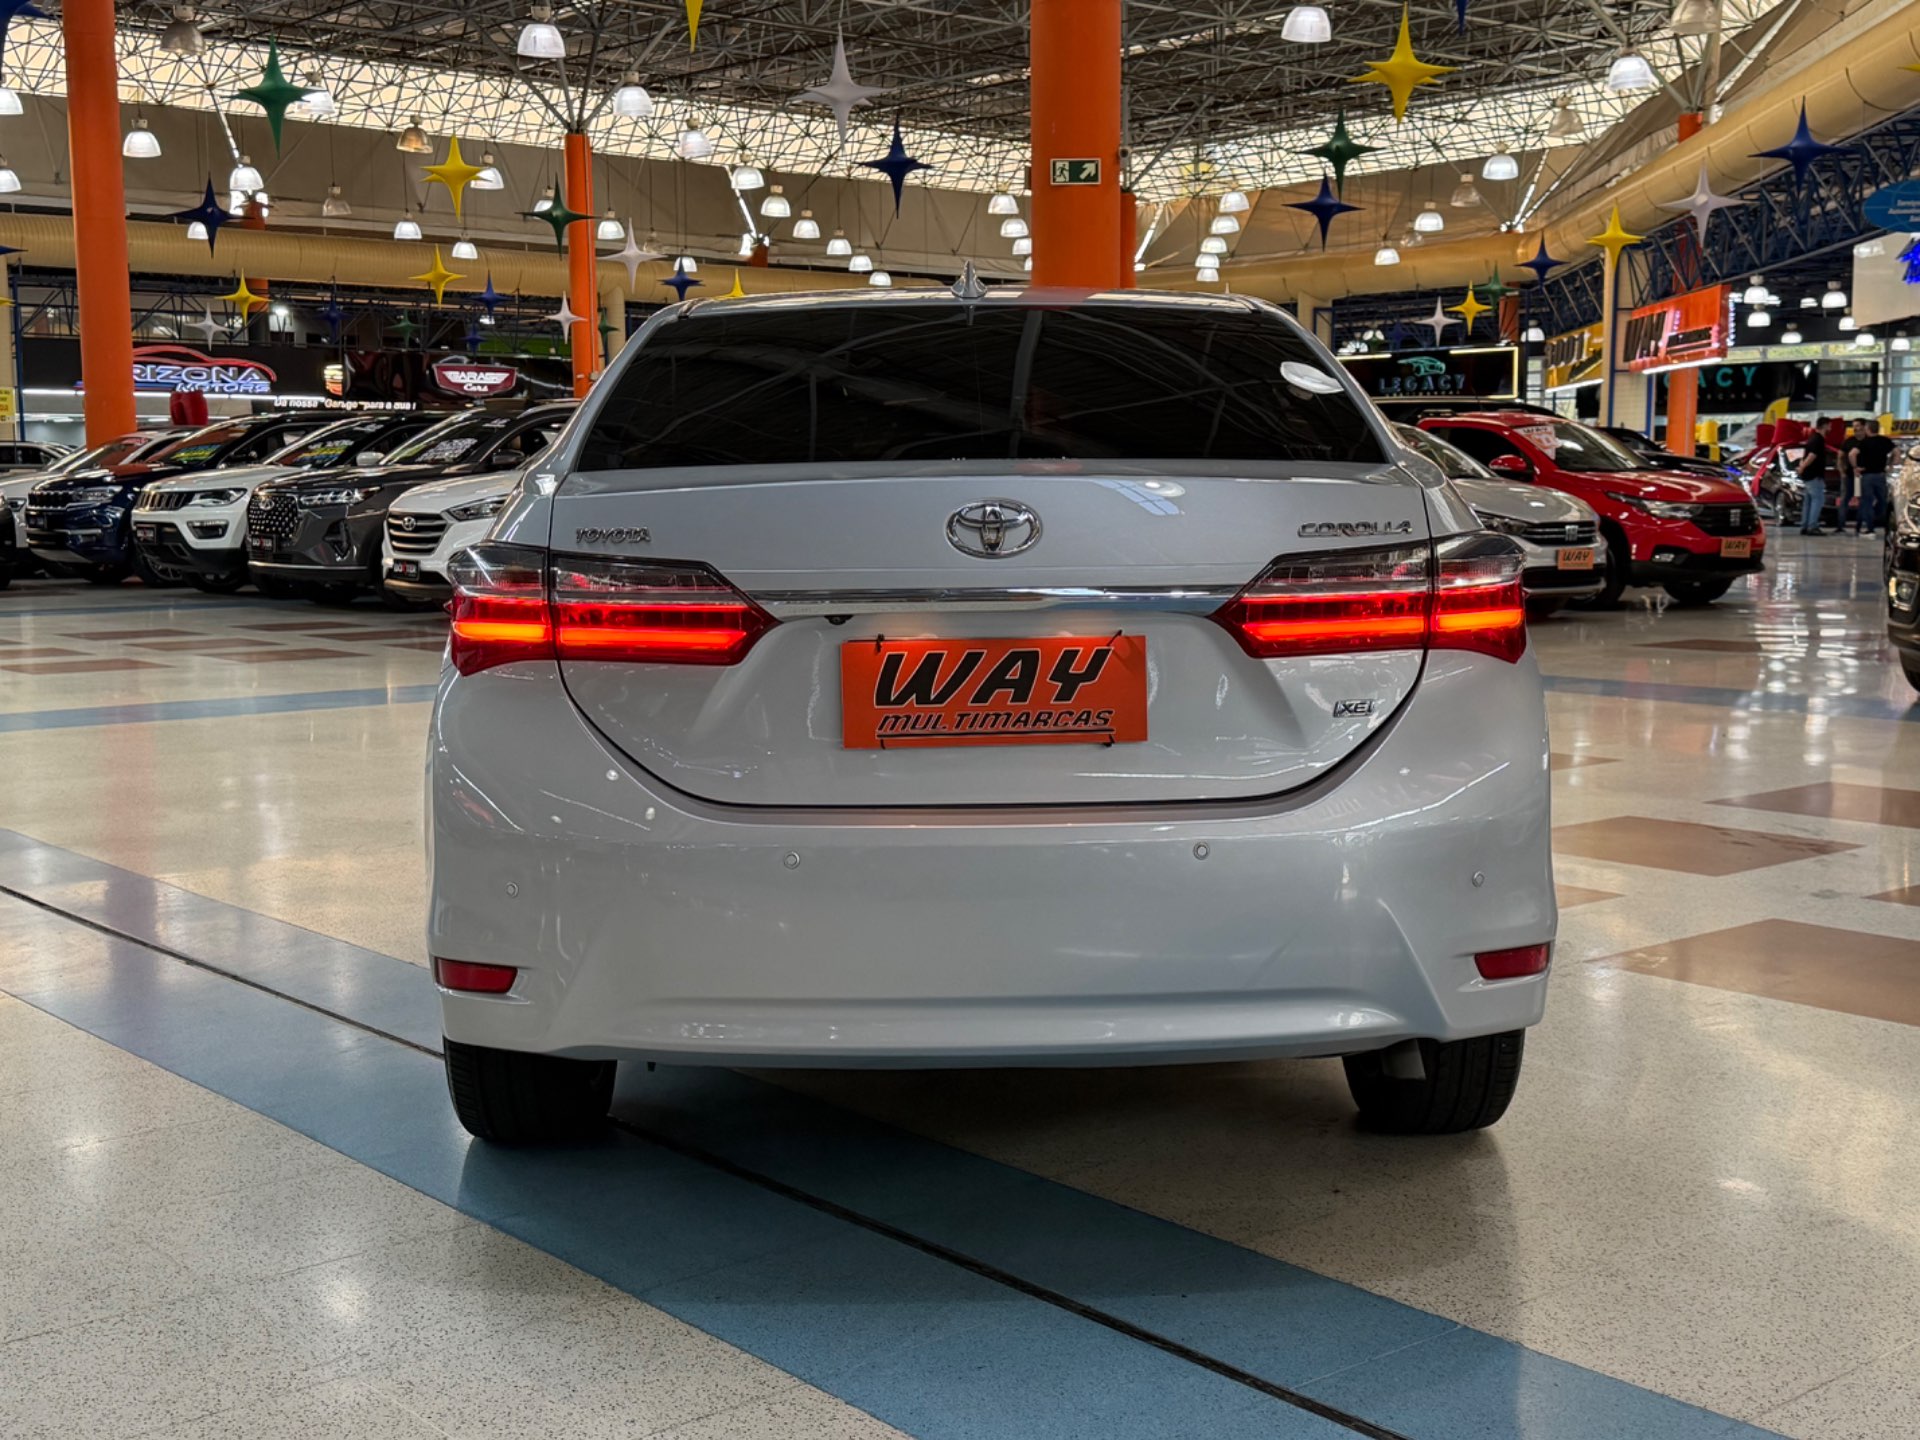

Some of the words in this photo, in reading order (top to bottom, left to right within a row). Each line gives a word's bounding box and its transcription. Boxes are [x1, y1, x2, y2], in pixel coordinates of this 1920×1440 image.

[176, 381, 271, 393] MOTORS
[1378, 374, 1466, 395] LEGACY
[576, 526, 651, 543] TOYOTA
[1297, 520, 1413, 538] COROLLA
[1724, 540, 1748, 551] WAY
[1562, 550, 1591, 562] WAY
[873, 646, 1115, 709] WAY
[876, 709, 1116, 733] MULTIMARCAS
